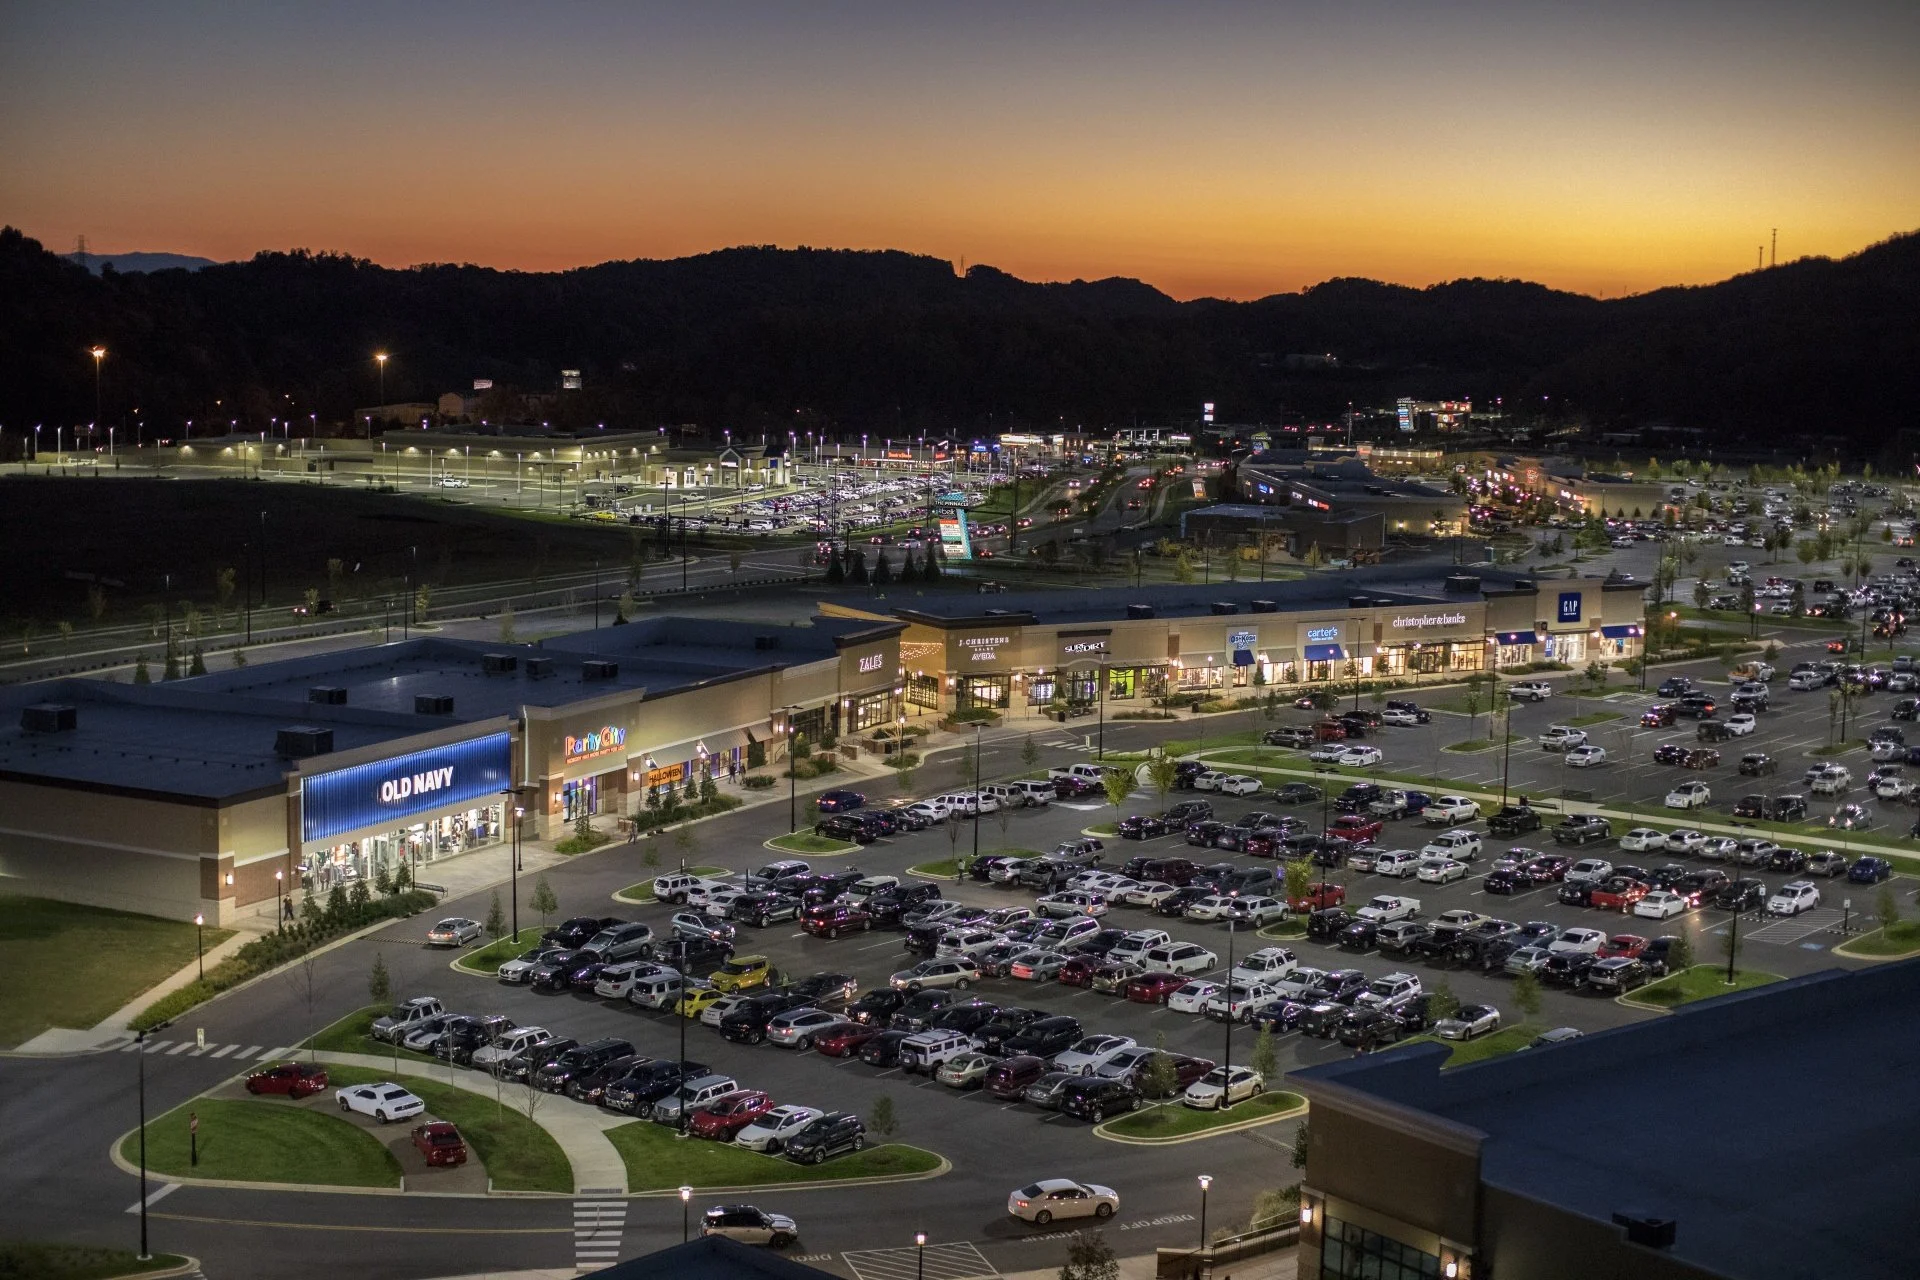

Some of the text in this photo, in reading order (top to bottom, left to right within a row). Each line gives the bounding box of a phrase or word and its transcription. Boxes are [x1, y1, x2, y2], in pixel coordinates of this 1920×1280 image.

[1563, 600, 1578, 613] GAP
[1392, 614, 1437, 628] christopher
[1443, 612, 1466, 624] banks
[1307, 627, 1338, 638] carter's
[1083, 641, 1105, 652] DIRT
[859, 654, 883, 672] ZALES
[971, 652, 996, 661] AVEDA
[565, 725, 626, 757] Party City
[649, 767, 682, 783] HALLOWEEN
[381, 765, 454, 802] OLD NAVY
[1119, 1219, 1151, 1231] OFF
[1151, 1214, 1195, 1226] DROP
